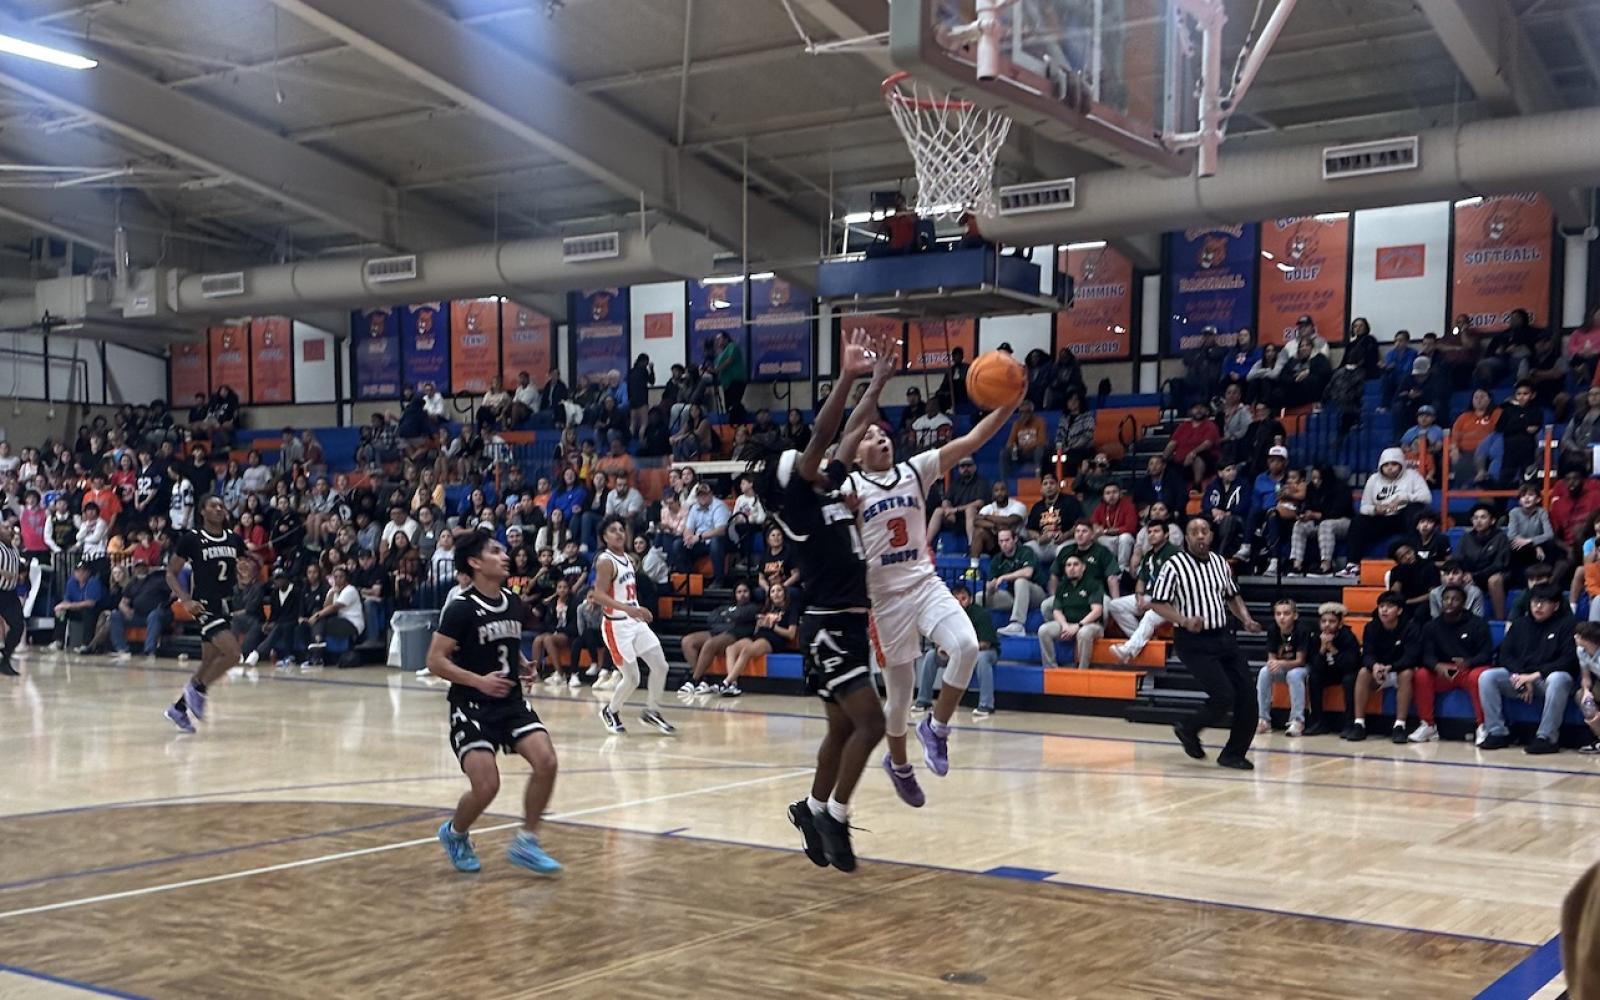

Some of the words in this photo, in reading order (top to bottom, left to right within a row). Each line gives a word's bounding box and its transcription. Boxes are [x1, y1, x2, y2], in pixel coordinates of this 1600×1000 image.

[1464, 247, 1540, 265] SOFTBALL
[886, 516, 909, 549] 3
[217, 560, 228, 581] 2
[497, 645, 511, 676] 3
